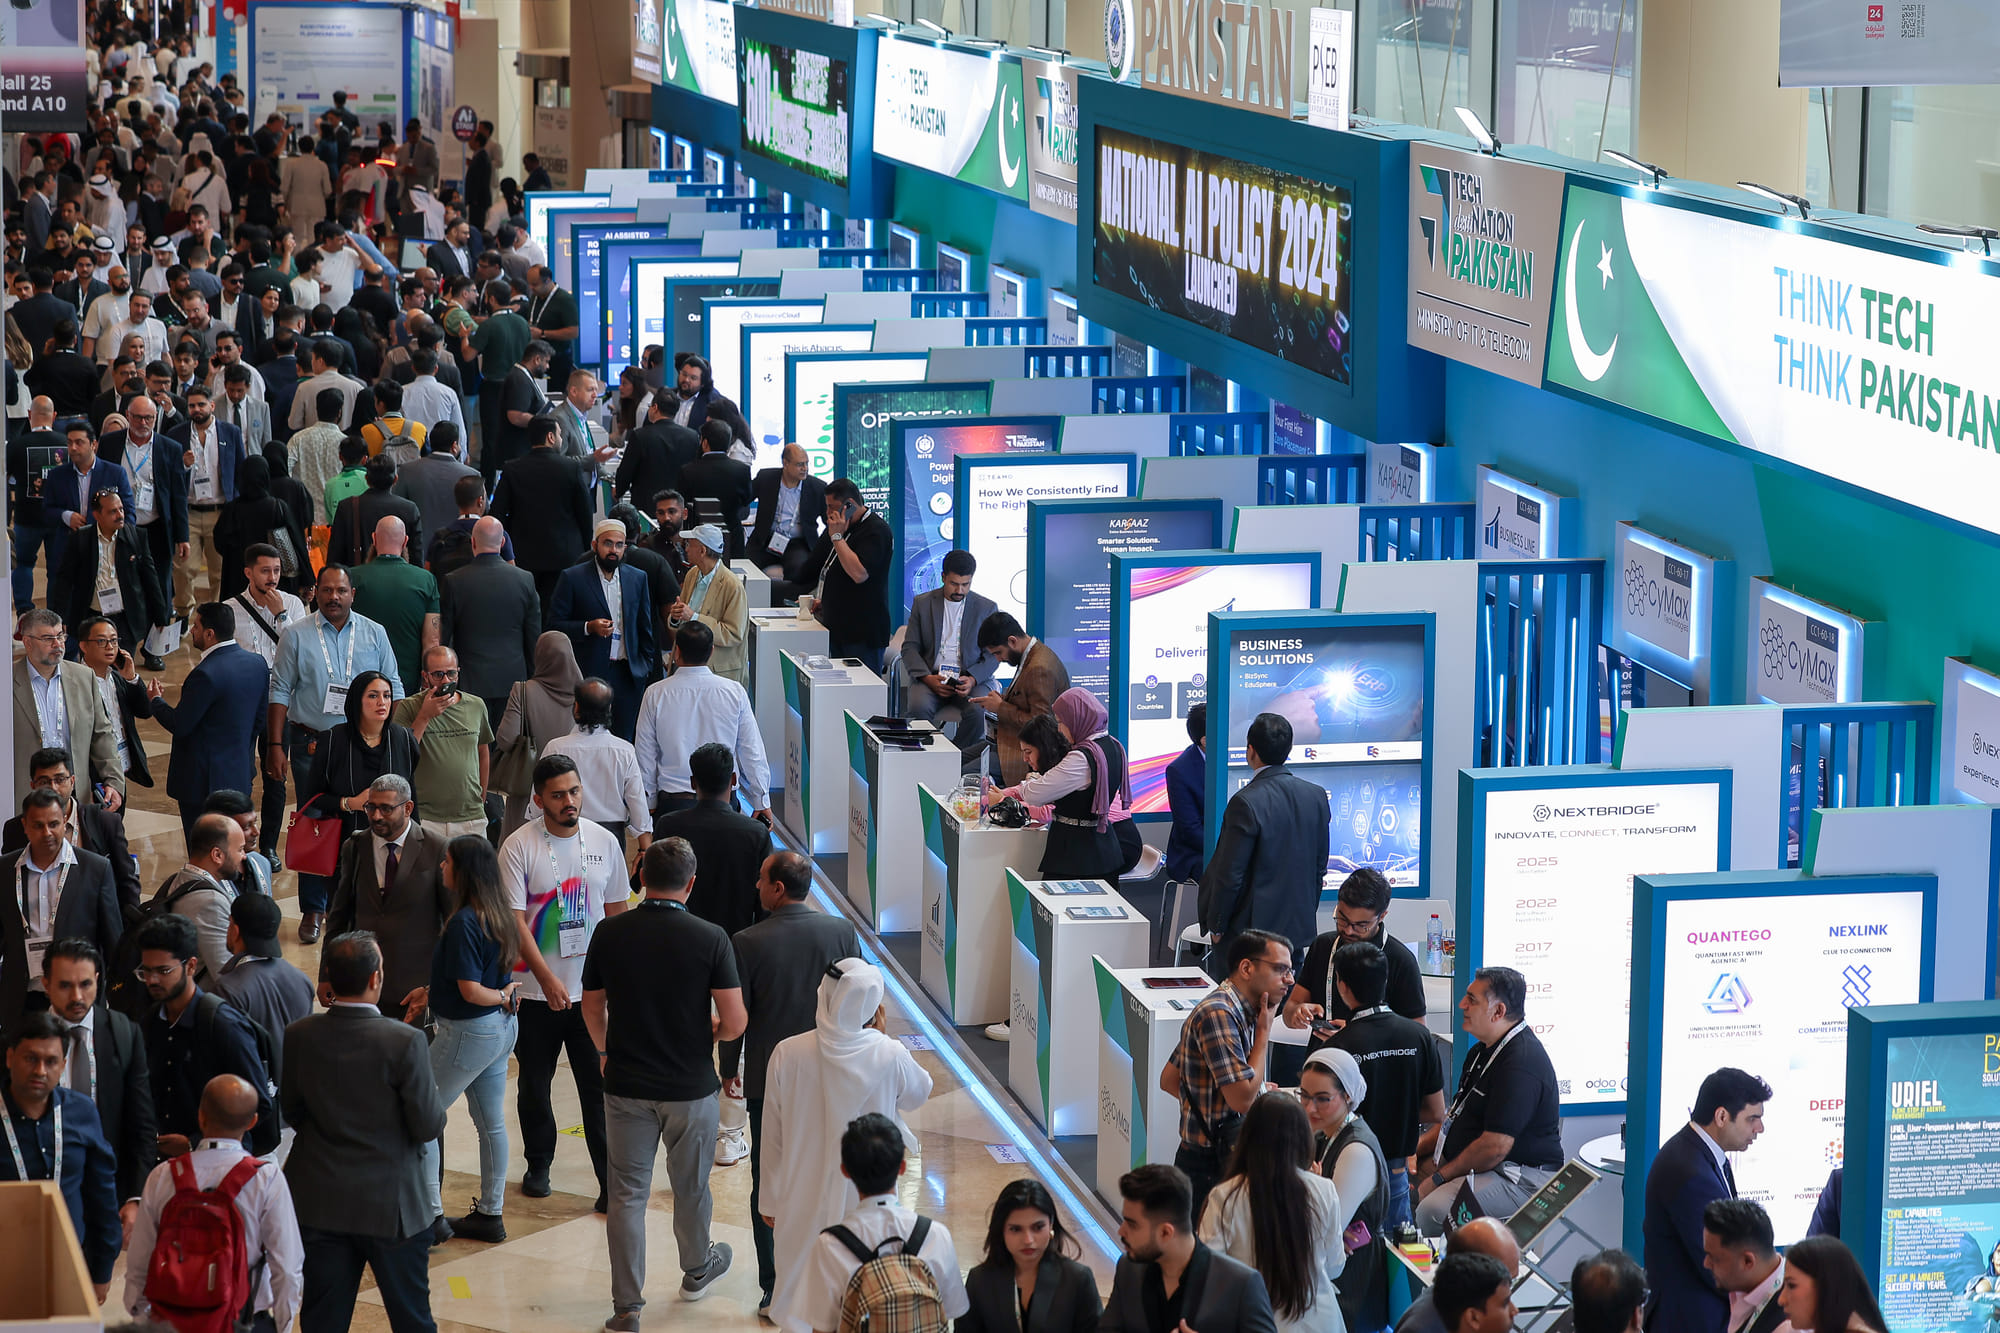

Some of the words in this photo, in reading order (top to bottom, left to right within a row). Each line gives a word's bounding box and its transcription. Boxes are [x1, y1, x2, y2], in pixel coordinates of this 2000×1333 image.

[1870, 9, 1881, 18] 24
[1142, 0, 1293, 112] PAKISTAN
[0, 74, 26, 91] all
[30, 74, 52, 91] 25
[909, 68, 929, 97] TECH
[32, 96, 67, 112] A10
[910, 104, 946, 137] PAKISTAN
[1453, 171, 1484, 204] TECH
[1101, 144, 1180, 248] NATIONAL
[1184, 167, 1203, 256] AI
[1208, 173, 1275, 279] POLICY
[1279, 194, 1338, 302] 2024
[614, 232, 650, 240] ASSISTED
[1450, 232, 1535, 302] PAKISTAN
[1185, 252, 1238, 316] LAUNCHED
[1774, 266, 1853, 335] THINK
[1860, 286, 1934, 356] TECH
[1416, 306, 1456, 339] MINISTRY
[1457, 320, 1469, 342] OF
[1470, 324, 1480, 346] IT
[1480, 328, 1487, 350] &
[1488, 330, 1532, 364] TELECOM
[1117, 343, 1145, 369] OPTOTECH
[1774, 334, 1852, 406] THINK
[1860, 358, 2000, 454] PAKISTAN
[1294, 422, 1304, 438] Hire
[1016, 440, 1045, 448] PAKISTAN
[978, 488, 1003, 498] How
[1006, 488, 1024, 497] We
[1026, 485, 1092, 497] Consistently
[1095, 484, 1119, 494] Find
[979, 501, 998, 510] The
[1097, 537, 1125, 546] Smarter
[1126, 536, 1160, 545] Solutions.
[1499, 526, 1524, 548] BUSINESS
[1524, 536, 1536, 554] LINE
[1128, 544, 1155, 552] Impact.
[1667, 562, 1690, 581] CC1-60-17
[1648, 579, 1689, 622] CyMax
[1663, 614, 1689, 633] Technologies
[1810, 624, 1836, 644] CC1-60-18
[1239, 639, 1303, 651] BUSINESS
[1239, 654, 1314, 666] SOLUTIONS
[1788, 640, 1836, 689] CyMax
[1244, 672, 1269, 681] BizSync
[1356, 674, 1389, 692] ERP
[1244, 680, 1278, 689] EduSphere
[1806, 678, 1836, 701] Technologies
[1146, 692, 1157, 702] 5+
[1494, 830, 1557, 840] INNOVATE,
[1622, 825, 1697, 836] TRANSFORM
[1516, 856, 1558, 867] 2025
[1516, 898, 1558, 909] 2022
[1686, 928, 1772, 945] QUANTEGO
[1828, 924, 1888, 938] NEXLINK
[1514, 942, 1553, 953] 2017
[1694, 952, 1728, 960] QUANTUM
[1849, 947, 1892, 955] CONNECTION
[1525, 983, 1552, 994] 012
[1720, 1030, 1763, 1039] CAPACITIES
[1586, 1078, 1616, 1089] odoo
[1892, 1080, 1942, 1108] URIEL
[1810, 1098, 1844, 1112] DEEP
[1905, 1208, 1942, 1218] CAPABILITIES
[1886, 1275, 1897, 1283] SET
[1899, 1274, 1908, 1282] UP
[1910, 1273, 1916, 1281] IN
[1918, 1272, 1945, 1281] MINUTES
[1885, 1282, 1911, 1292] SUCCEED
[1913, 1281, 1925, 1290] FOR
